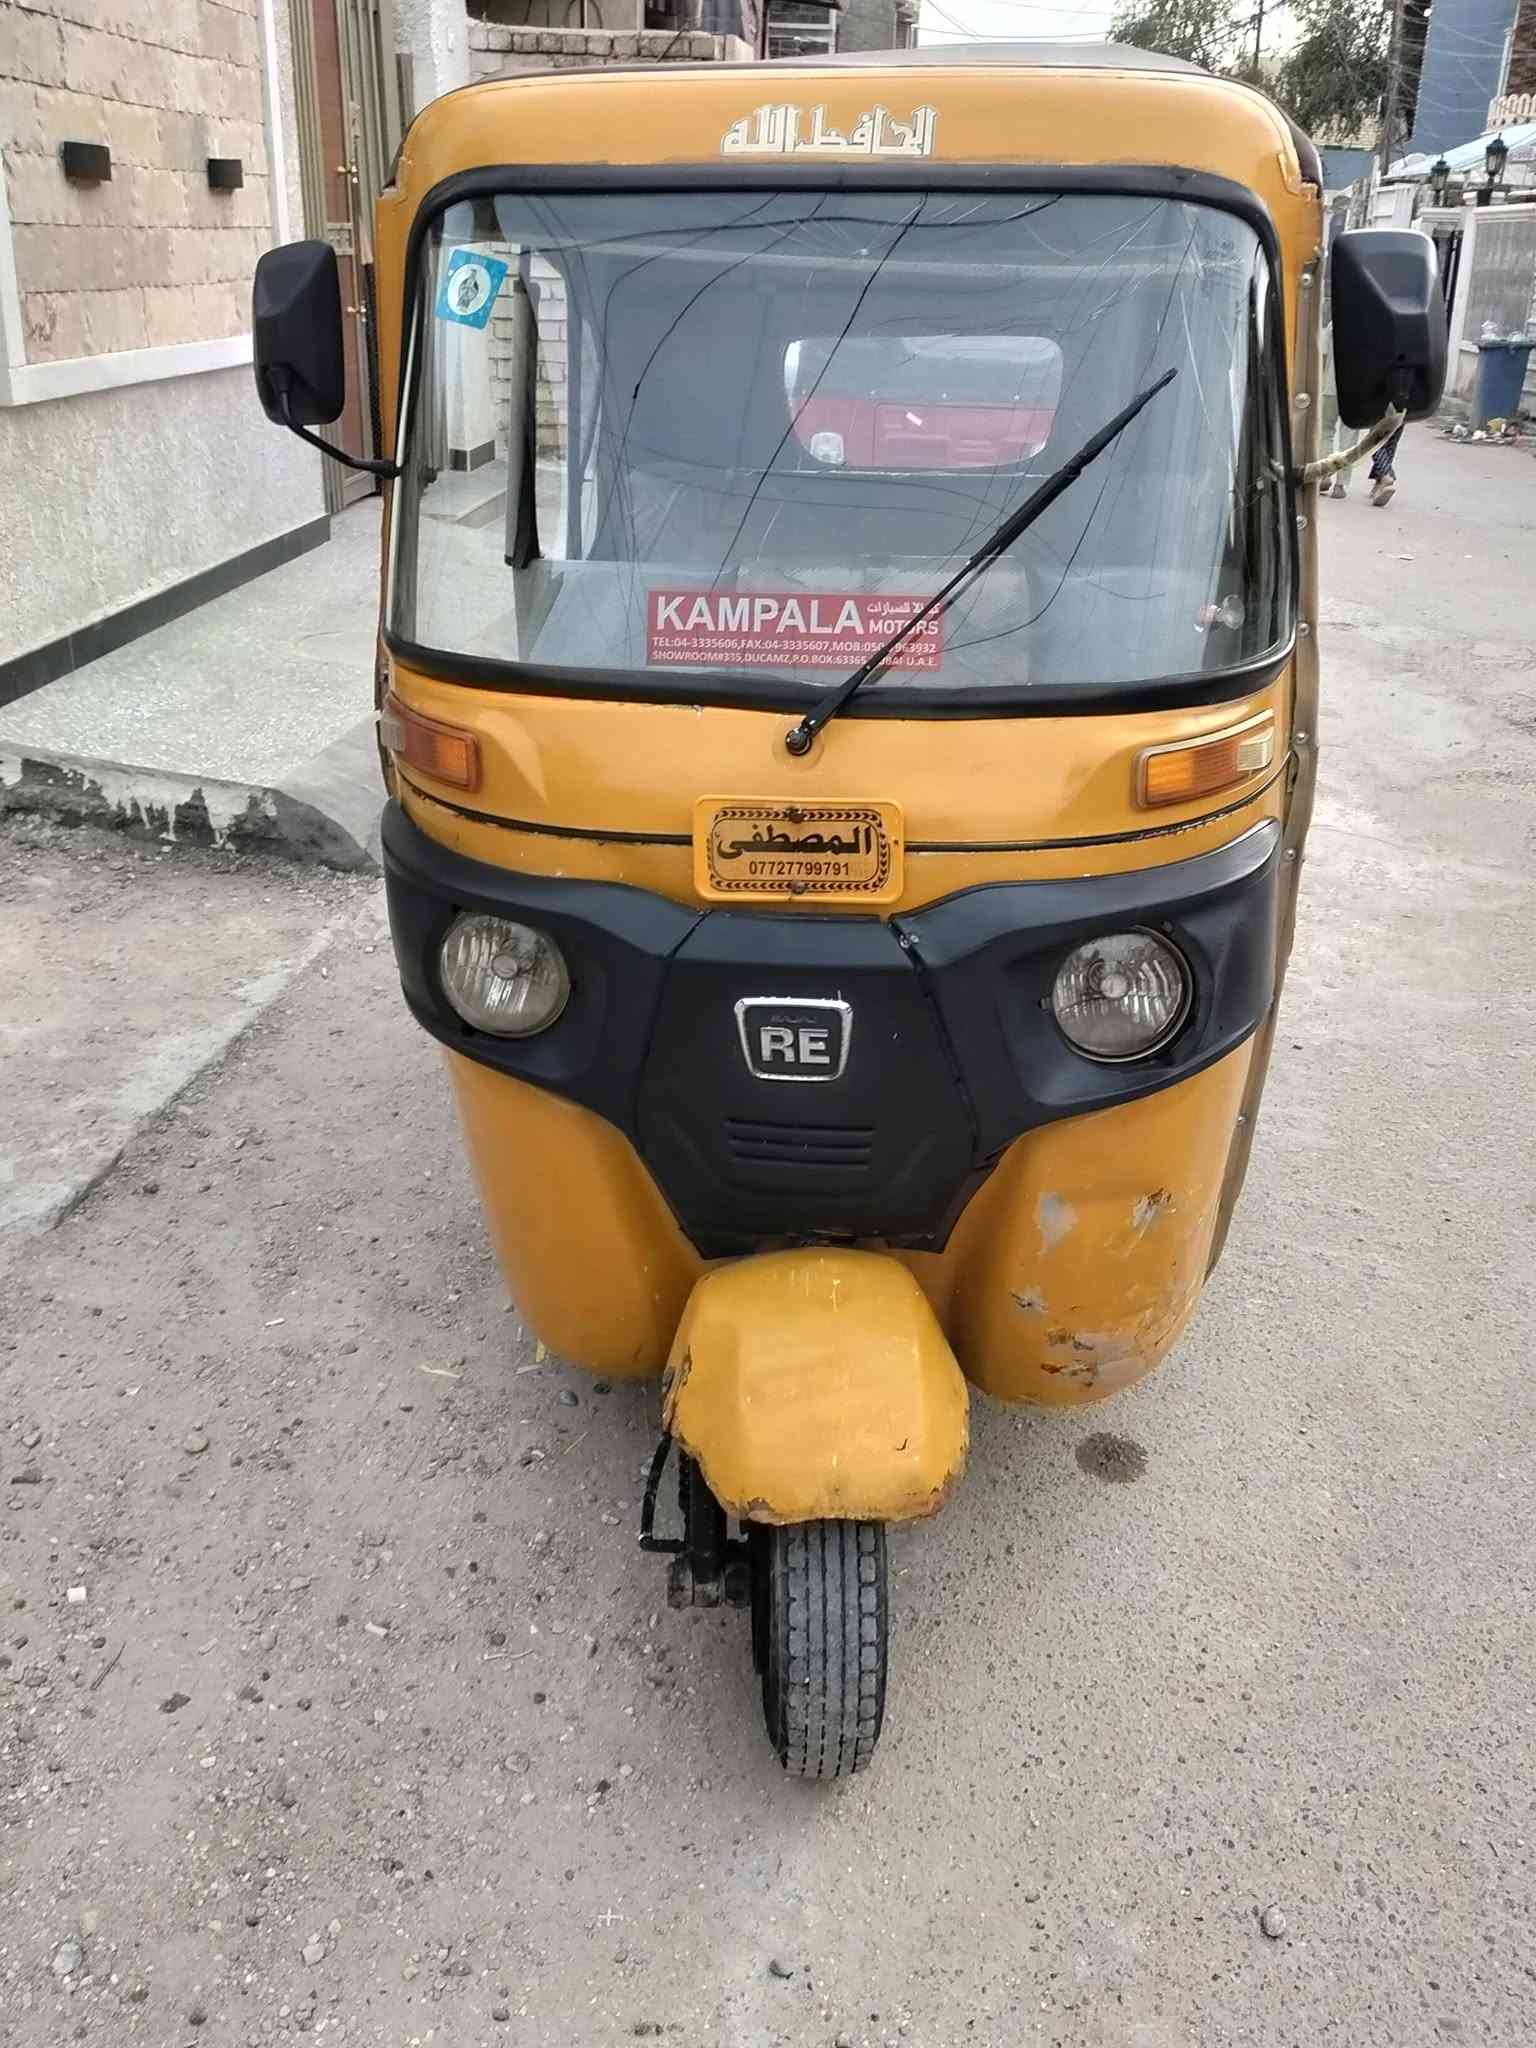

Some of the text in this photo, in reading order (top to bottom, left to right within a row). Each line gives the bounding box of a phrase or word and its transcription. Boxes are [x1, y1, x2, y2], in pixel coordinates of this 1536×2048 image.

[721, 104, 797, 153] الله
[656, 595, 864, 635] KAMPALA
[717, 824, 872, 860] المصطفى
[749, 861, 850, 876] 07727799791
[760, 1026, 830, 1064] RE
